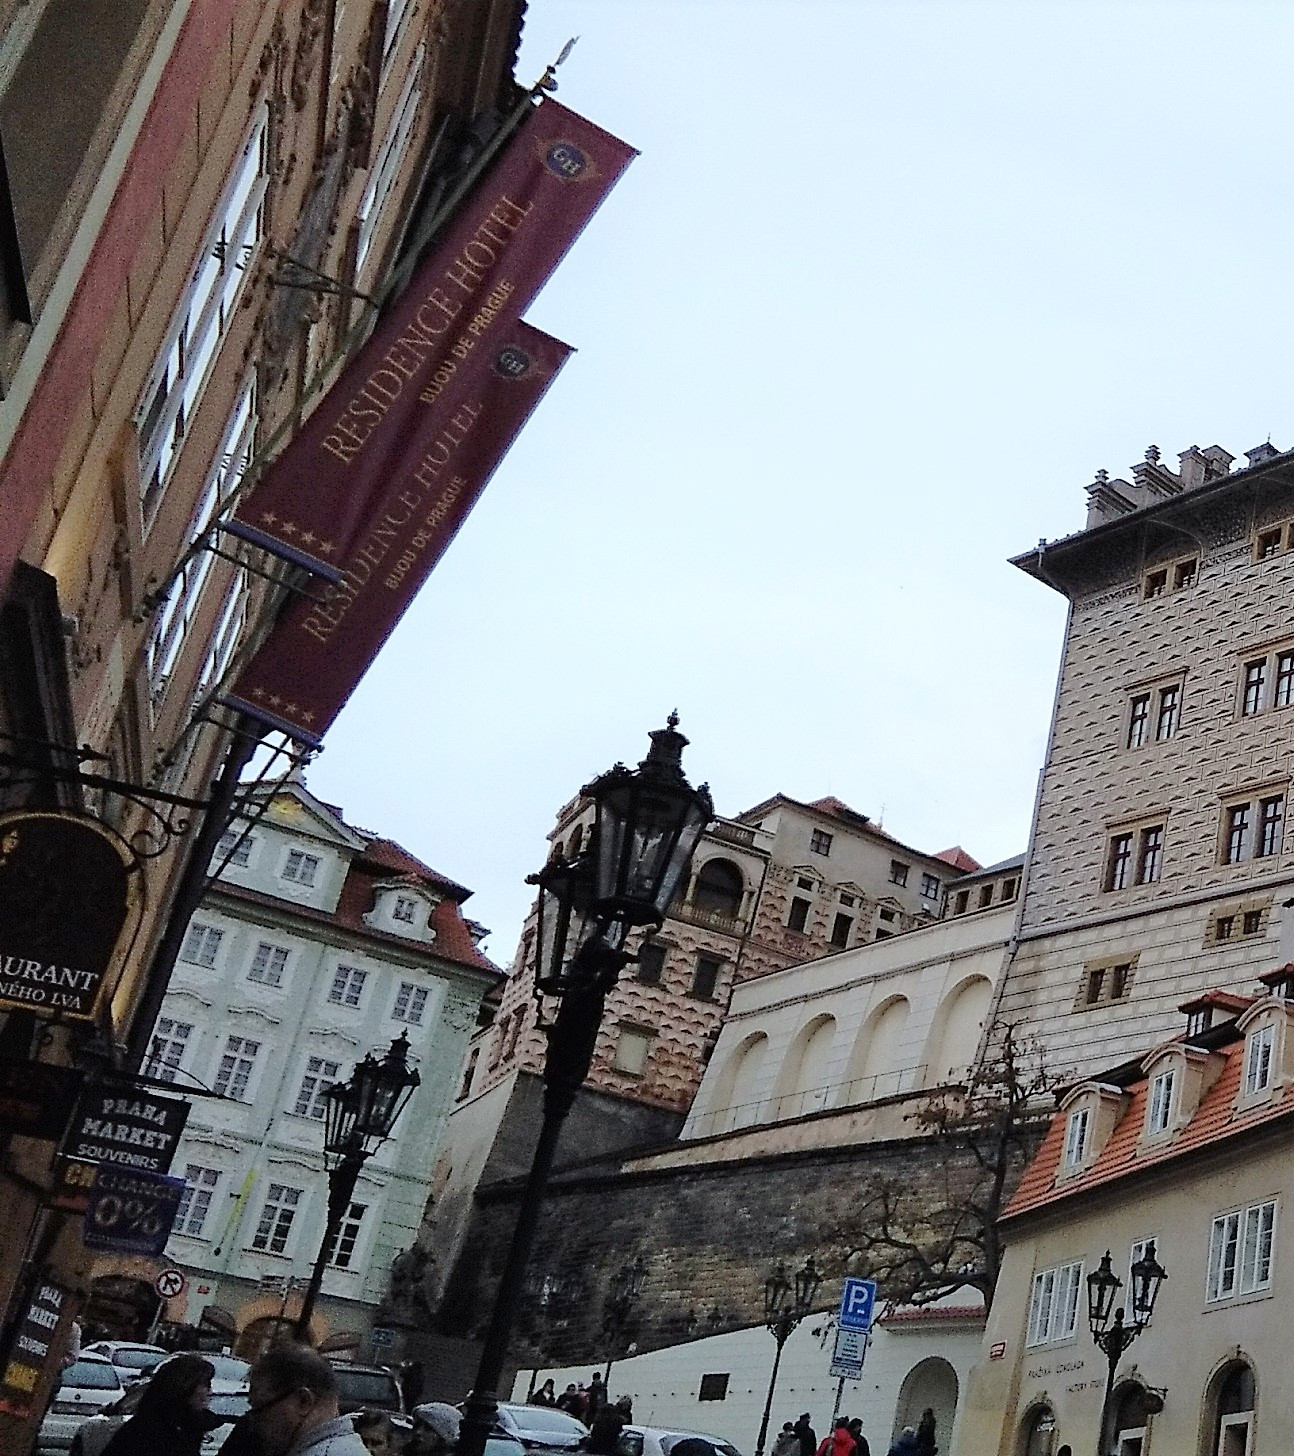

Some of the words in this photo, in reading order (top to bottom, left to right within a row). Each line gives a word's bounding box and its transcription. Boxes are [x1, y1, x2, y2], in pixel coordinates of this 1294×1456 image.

[321, 287, 464, 464] RESIDENCE
[445, 195, 534, 293] HOTEL
[419, 360, 458, 404] BIJOU
[452, 337, 475, 359] DE
[469, 279, 516, 336] PRAGUE
[301, 491, 422, 643] RESIDENCE
[414, 402, 484, 489] HOTEL
[385, 552, 417, 590] BIJOU
[412, 529, 433, 549] DE
[426, 475, 468, 527] PRAGUE
[0, 954, 99, 991] URANT
[51, 992, 81, 1009] LVA
[81, 1117, 172, 1150] MARKET
[77, 1143, 160, 1169] SOUVENIRS
[94, 1196, 161, 1235] 0%
[847, 1284, 869, 1313] P
